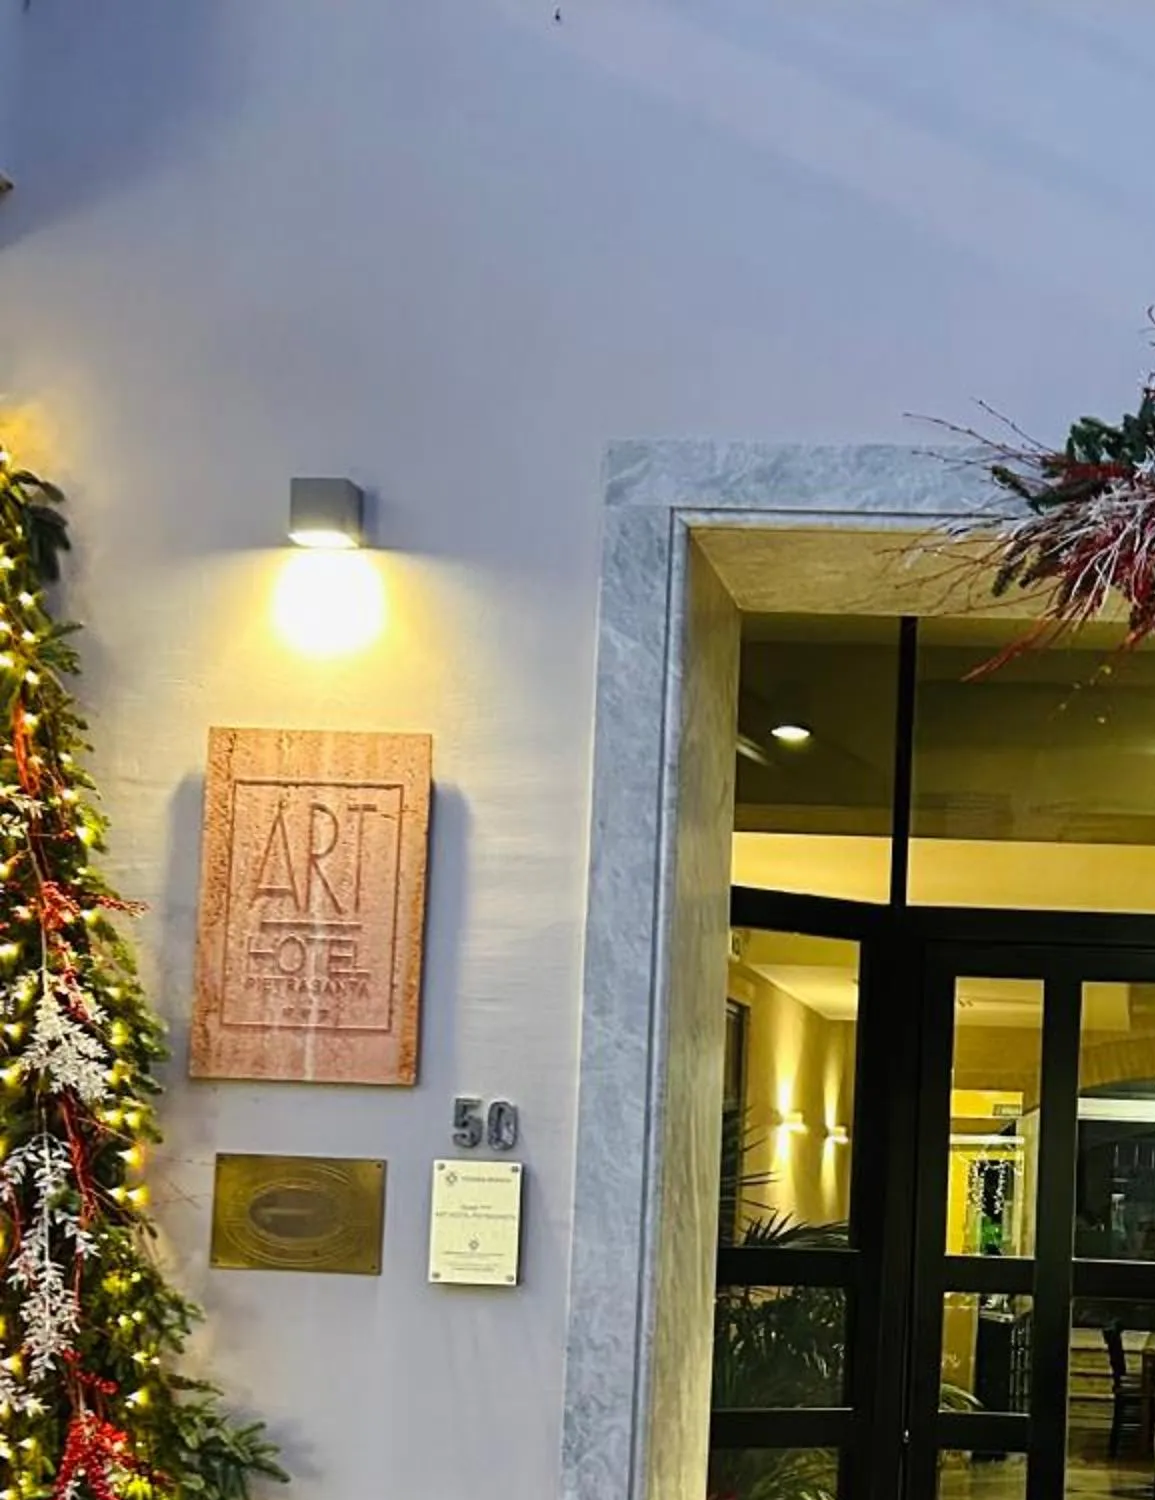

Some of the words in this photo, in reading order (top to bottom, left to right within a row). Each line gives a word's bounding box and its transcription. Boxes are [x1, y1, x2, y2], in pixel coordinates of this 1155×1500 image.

[249, 800, 377, 915] ART
[246, 935, 371, 978] HOTEL
[453, 1097, 518, 1151] 50
